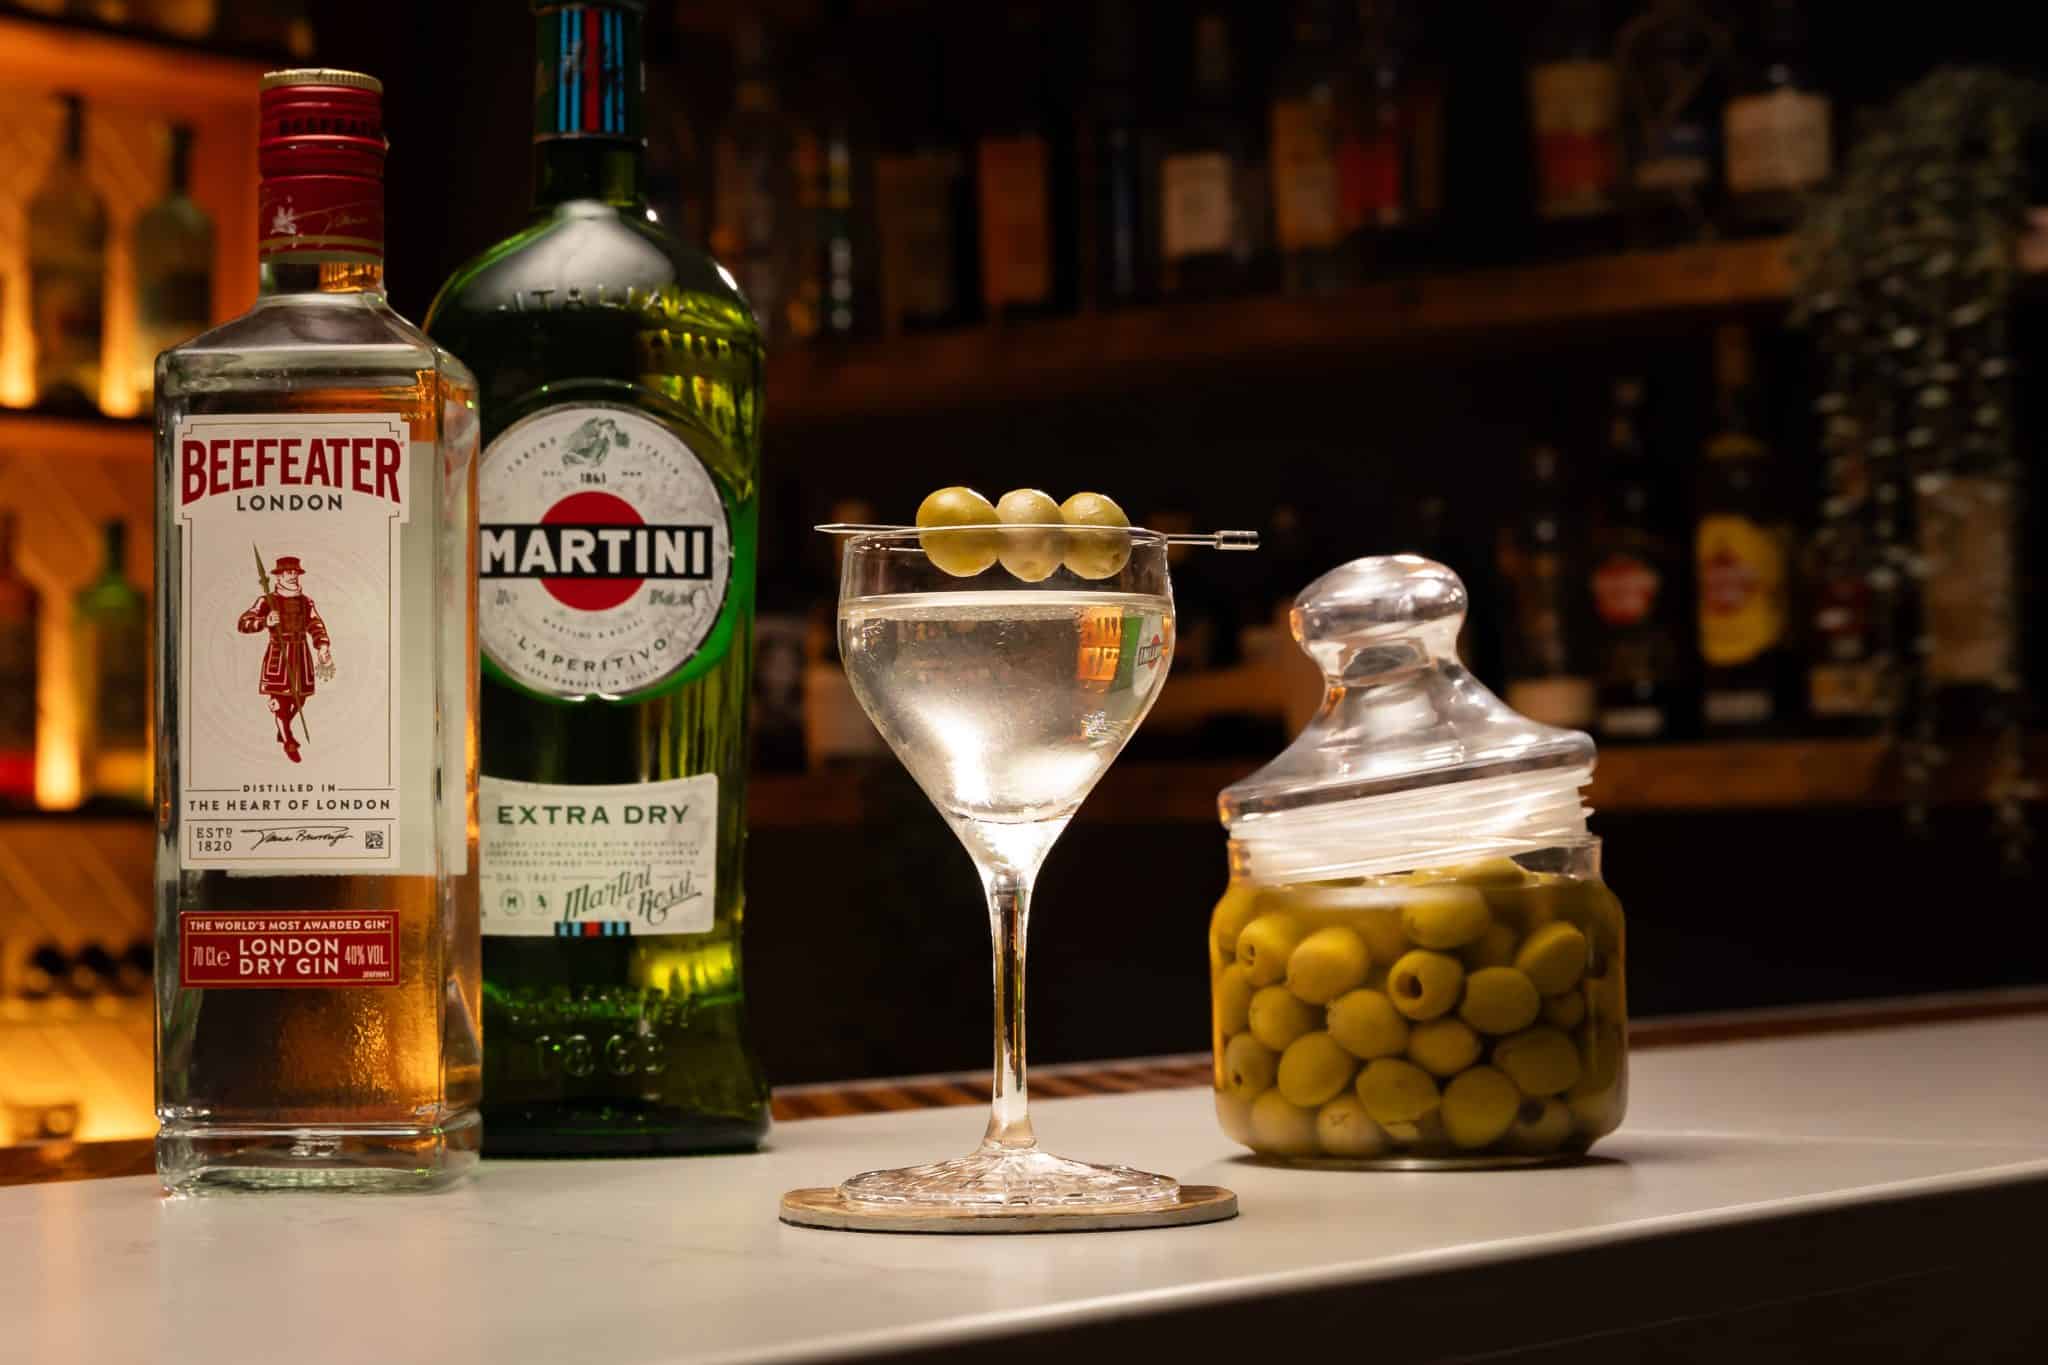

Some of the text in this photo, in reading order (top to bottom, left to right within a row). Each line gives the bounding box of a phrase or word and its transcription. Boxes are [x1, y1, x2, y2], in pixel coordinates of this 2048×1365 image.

[182, 438, 401, 505] BEEFEATER
[236, 494, 343, 511] LONDON
[480, 529, 705, 574] MARTINI
[517, 636, 667, 672] L'APERITIVO
[243, 784, 336, 793] DISTILLED IN
[189, 799, 391, 811] THE HEART OF LONDON
[497, 804, 690, 825] EXTRA DRY
[198, 840, 232, 852] 1820
[190, 920, 212, 931] THE
[214, 920, 265, 931] WORLD'S
[268, 920, 300, 931] MOST
[303, 920, 361, 930] AWARDED
[239, 938, 340, 956] LONDON
[344, 944, 366, 967] 40%
[239, 957, 339, 976] DRY GIN
